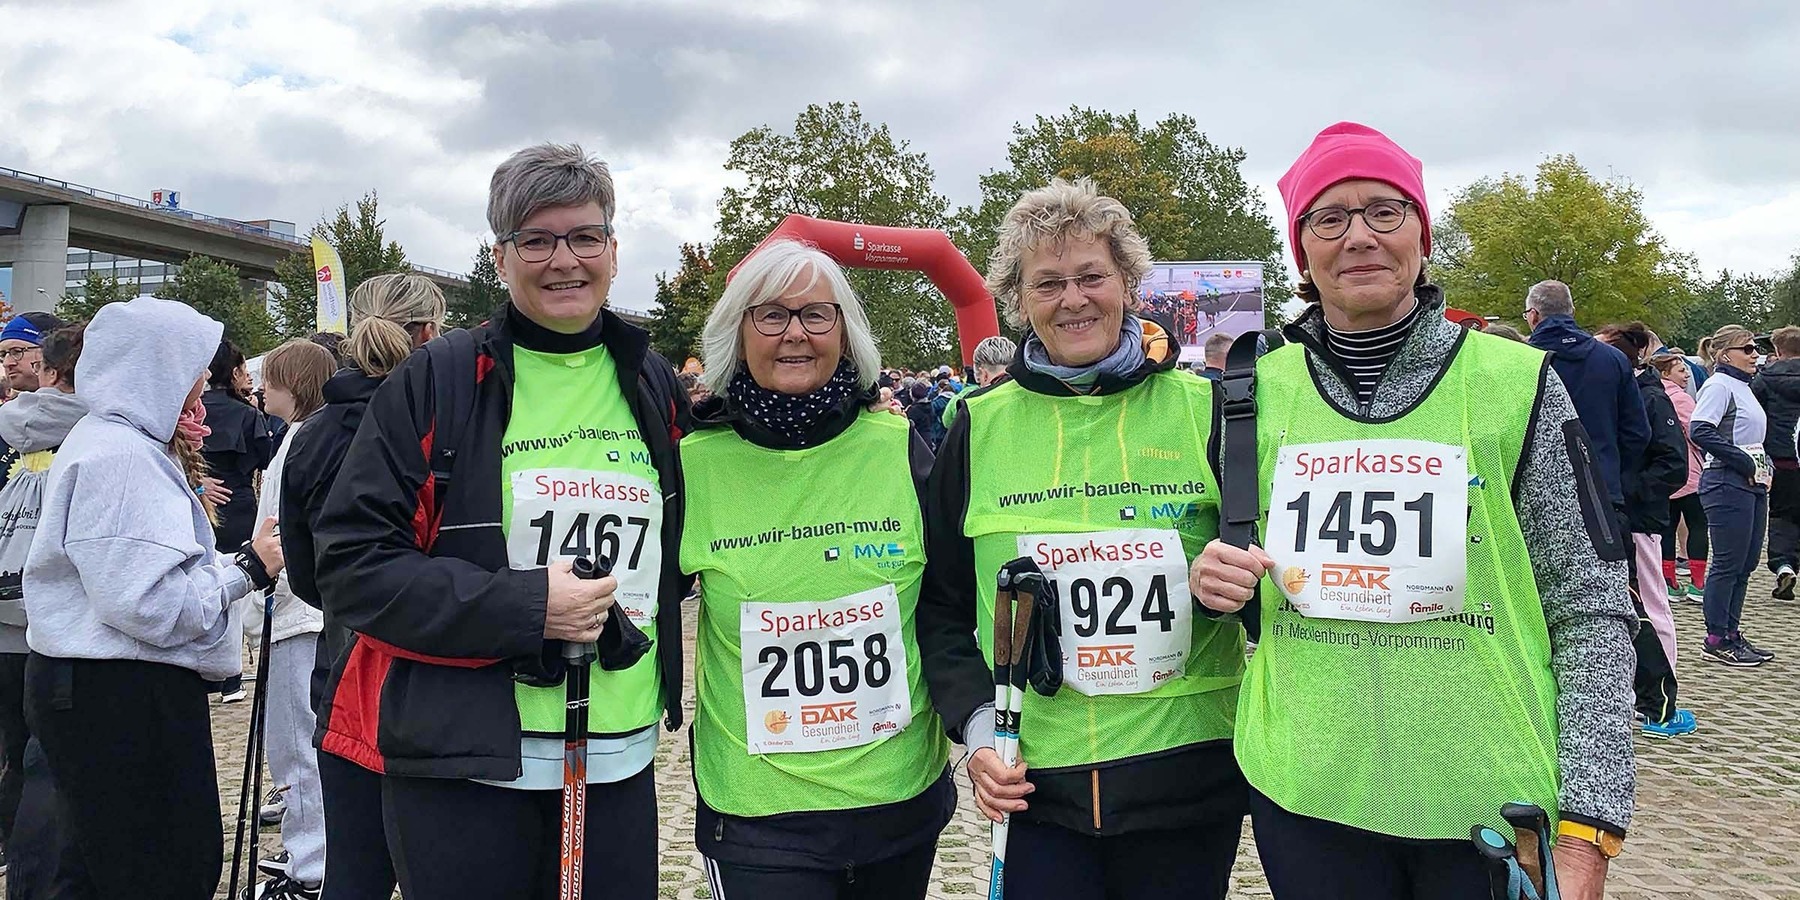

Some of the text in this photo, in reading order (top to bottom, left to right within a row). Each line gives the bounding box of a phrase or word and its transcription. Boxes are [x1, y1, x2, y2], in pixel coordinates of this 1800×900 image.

[865, 253, 908, 263] Vorpommern
[867, 241, 901, 253] Sparkasse
[1295, 448, 1442, 481] Sparkasse
[535, 475, 650, 503] Sparkasse
[999, 480, 1206, 507] www.wir-bauen-mv.de
[1152, 503, 1185, 519] MV
[710, 517, 901, 552] www.wir-bauen-mv.de
[1286, 491, 1434, 558] 1451
[530, 510, 650, 570] 1467
[855, 543, 885, 559] MV
[1037, 540, 1163, 570] Sparkasse
[1320, 563, 1391, 591] DAK
[1320, 587, 1391, 605] Gesundheit
[760, 601, 884, 637] Sparkasse
[1409, 602, 1443, 614] famila
[1272, 620, 1283, 636] in
[758, 632, 891, 698] 2058
[1077, 645, 1136, 667] DAK
[1077, 667, 1138, 681] Gesundheit
[801, 701, 858, 725] DAK
[802, 722, 860, 738] Gesundheit
[872, 721, 897, 734] famila
